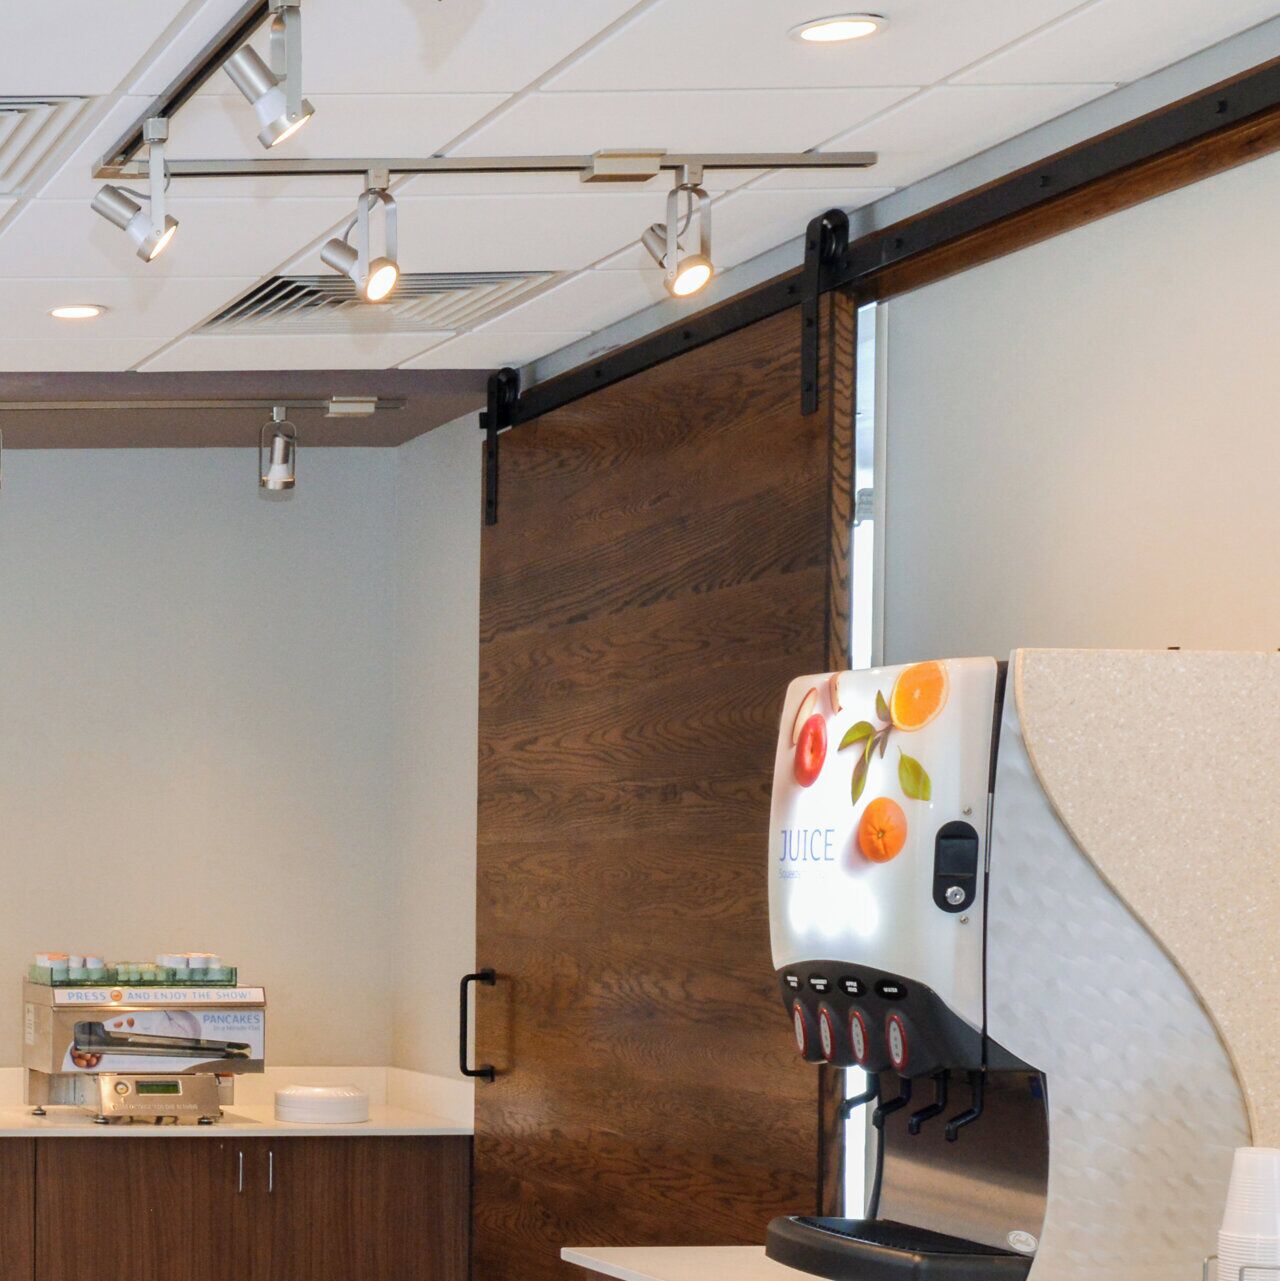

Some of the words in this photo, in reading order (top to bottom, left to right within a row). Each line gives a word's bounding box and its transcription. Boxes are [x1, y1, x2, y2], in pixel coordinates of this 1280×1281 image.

[779, 829, 835, 861] JUICE
[67, 991, 107, 1001] PRESS
[127, 991, 150, 1001] AND
[153, 991, 188, 1001] ENJOY
[192, 990, 211, 1000] THE
[202, 1013, 261, 1024] PANCAKES
